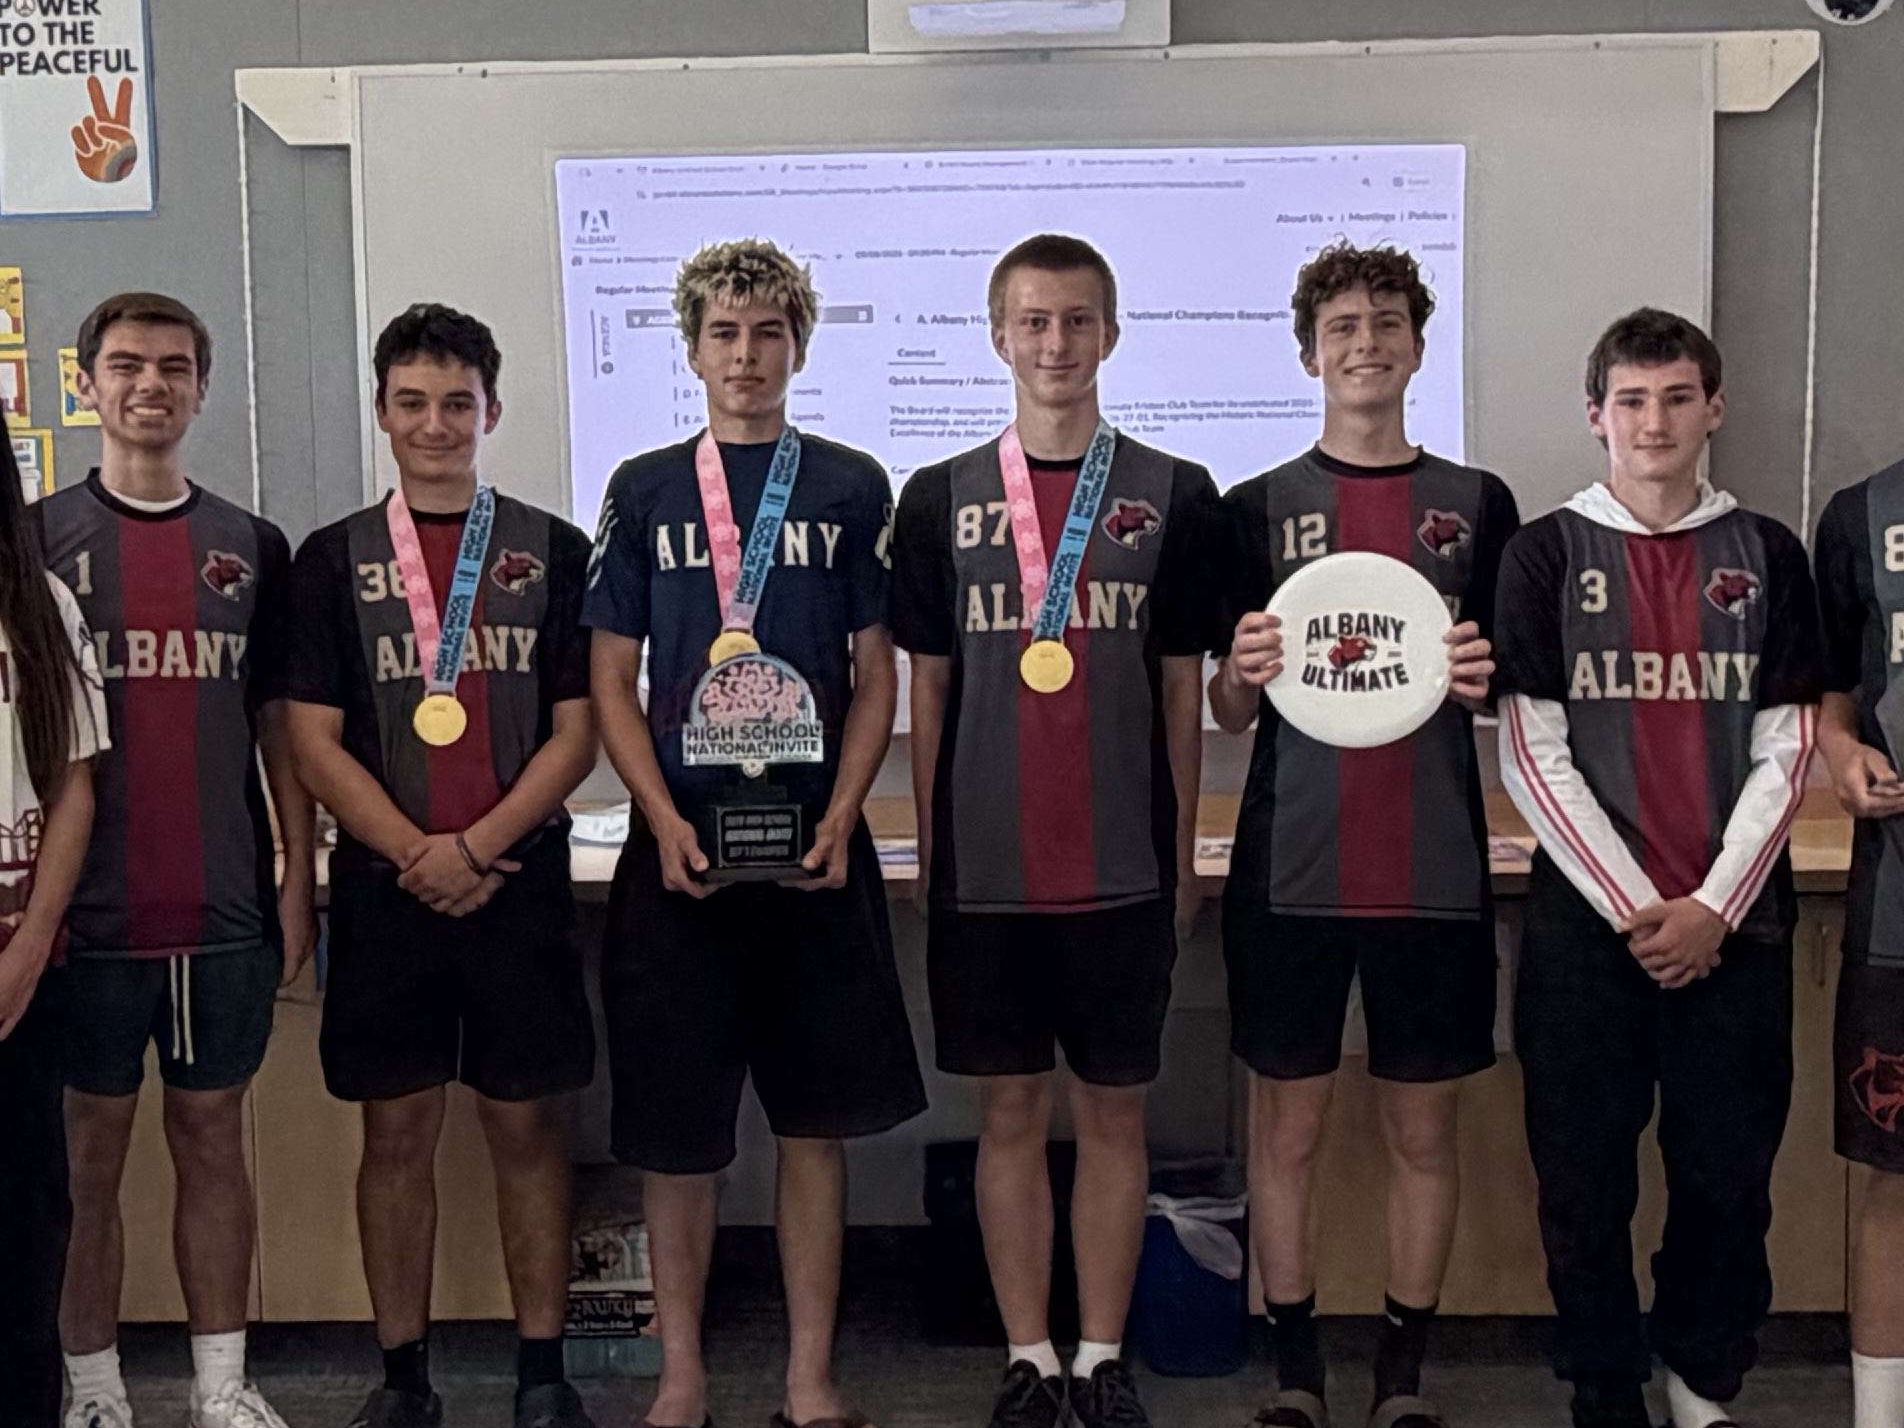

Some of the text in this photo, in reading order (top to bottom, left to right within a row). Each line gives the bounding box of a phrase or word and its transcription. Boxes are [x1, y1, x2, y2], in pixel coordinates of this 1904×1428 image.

[43, 20, 96, 46] THE
[635, 285, 677, 294] Meetin
[930, 314, 969, 327] Albany
[1237, 310, 1292, 322] Recogniti
[972, 376, 1012, 386] Abstrac
[655, 520, 844, 572] ALNY
[956, 501, 1013, 550] 87
[1281, 512, 1328, 561] 12
[1044, 550, 1071, 607] SCHOOL
[1578, 568, 1609, 614] 3
[440, 593, 463, 646] SCHOOL
[965, 580, 1148, 633] ALNY
[1048, 591, 1070, 637] ATIONAL
[1304, 611, 1408, 645] ALBANY
[96, 629, 248, 681] LBANY
[376, 624, 538, 683] ALANY
[1567, 649, 1762, 703] ALBANY
[1301, 662, 1411, 693] ULTIMATE
[685, 723, 822, 742] HIGH SCHOOL
[685, 738, 820, 756] NATIONAL INVITE
